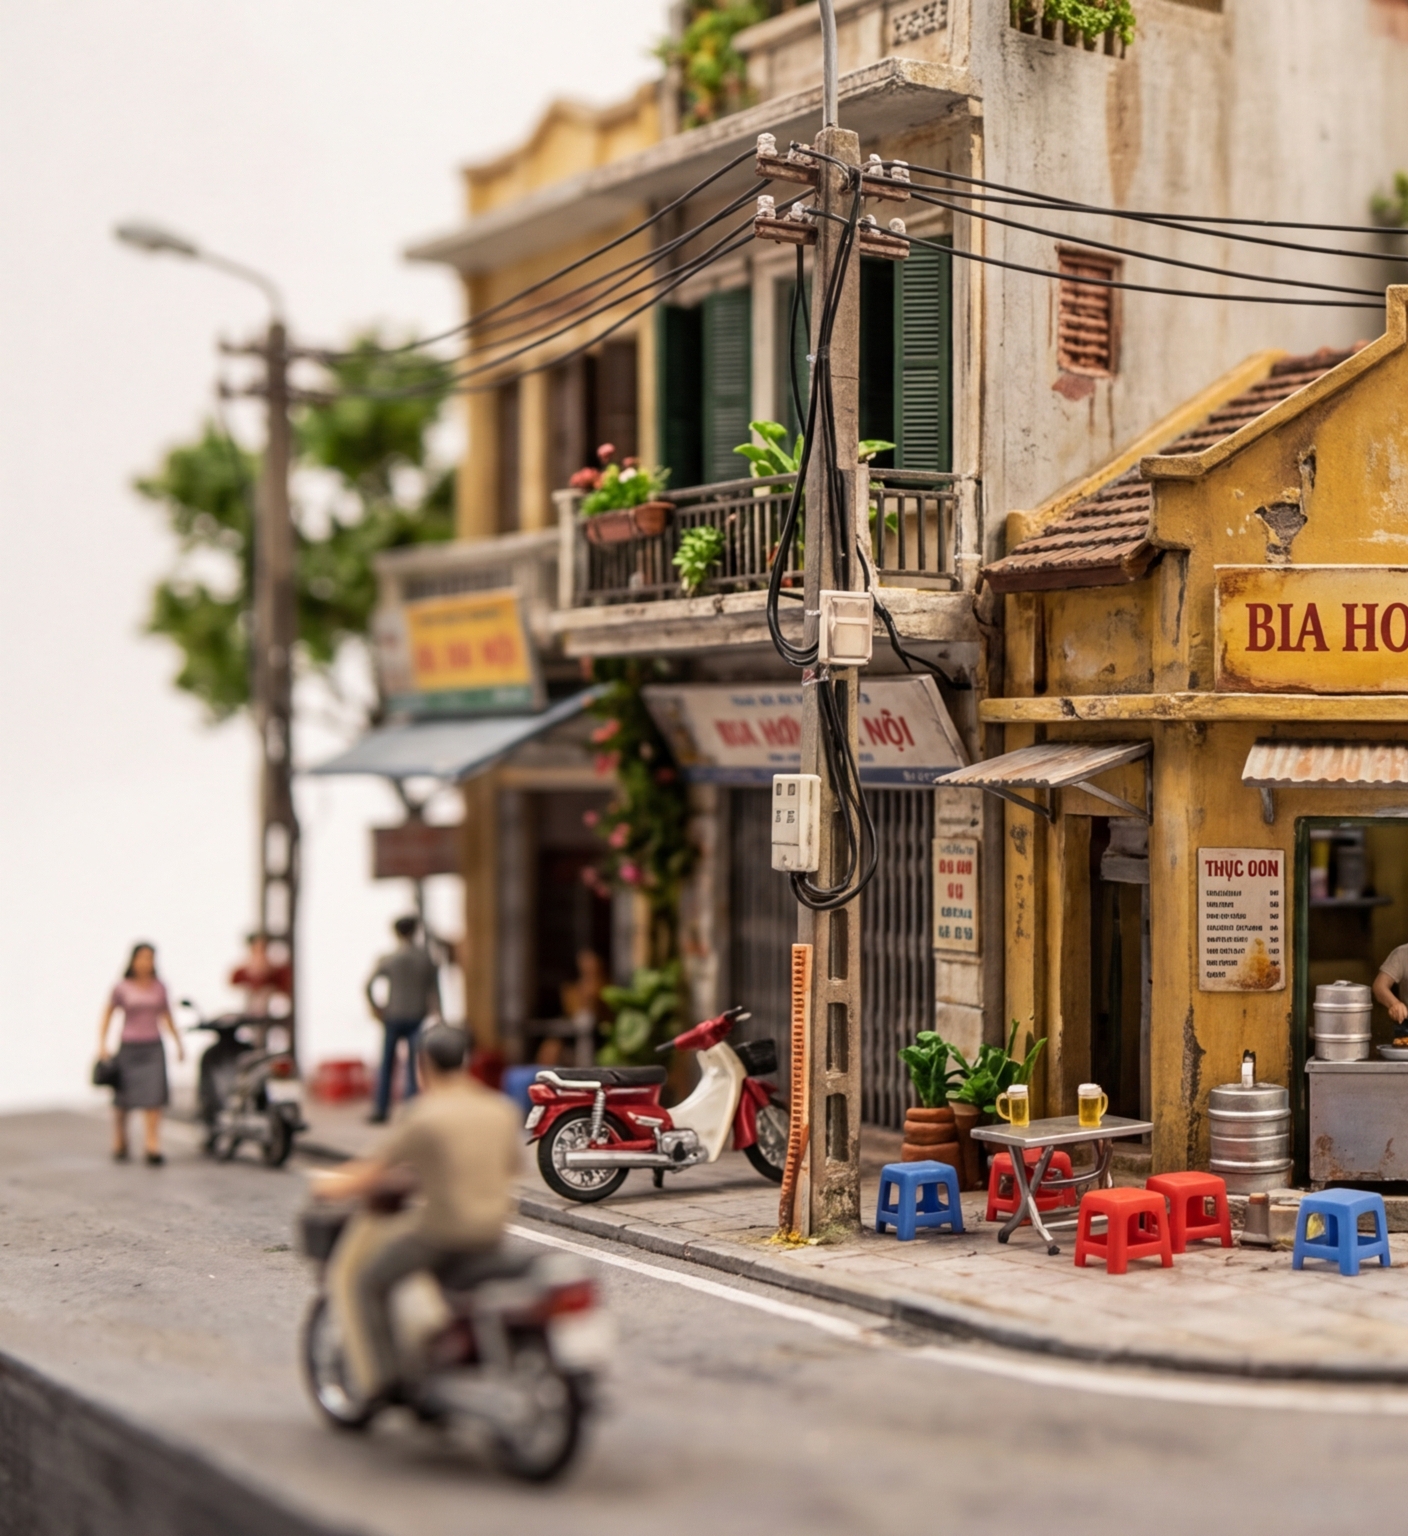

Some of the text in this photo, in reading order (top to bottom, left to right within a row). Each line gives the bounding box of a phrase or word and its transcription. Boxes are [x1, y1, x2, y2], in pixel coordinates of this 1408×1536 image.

[1244, 602, 1330, 652] BIA
[862, 708, 915, 752] NỘI
[1205, 859, 1244, 882] THỤC
